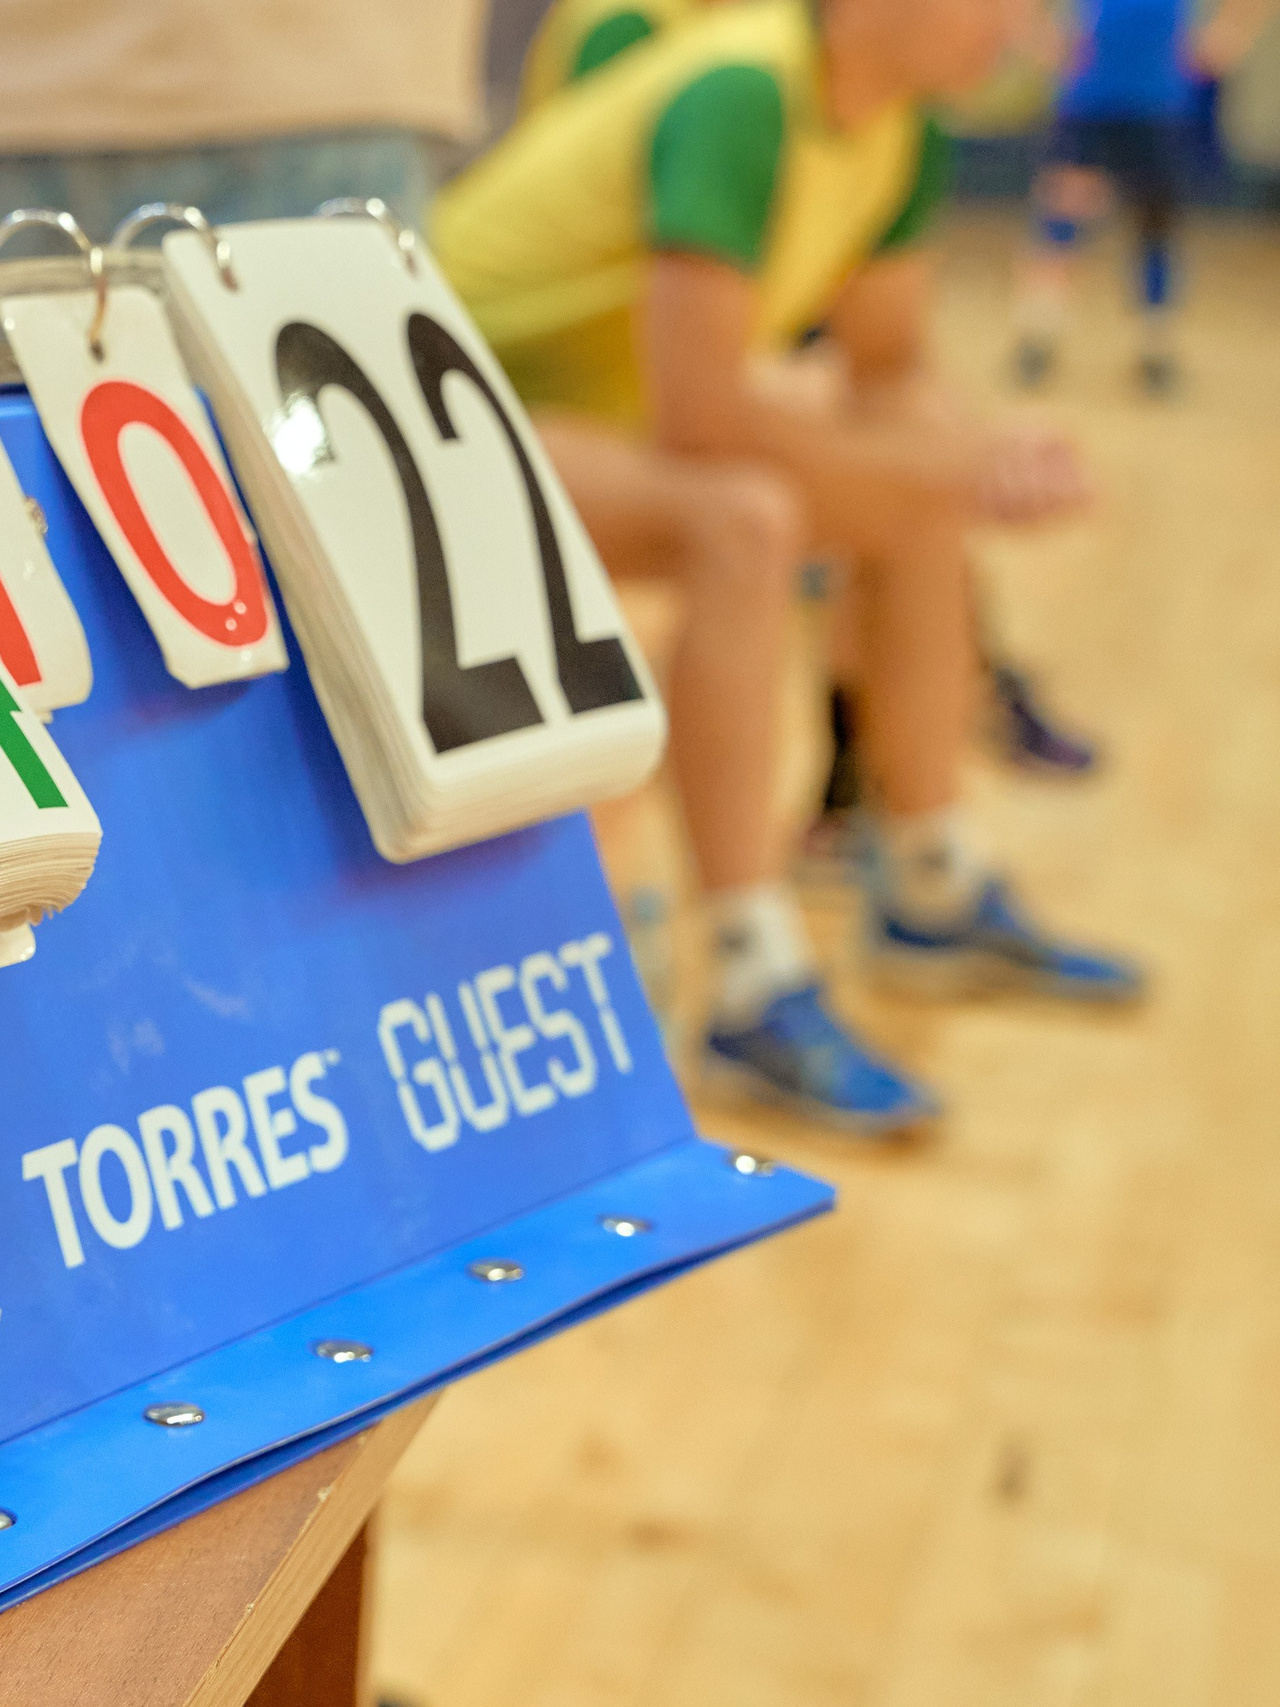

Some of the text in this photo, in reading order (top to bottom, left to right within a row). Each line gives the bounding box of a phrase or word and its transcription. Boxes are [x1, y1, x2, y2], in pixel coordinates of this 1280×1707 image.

[81, 381, 267, 647] 0
[275, 313, 646, 755] 22
[22, 1051, 348, 1269] TORRES
[377, 932, 634, 1152] GUEST
